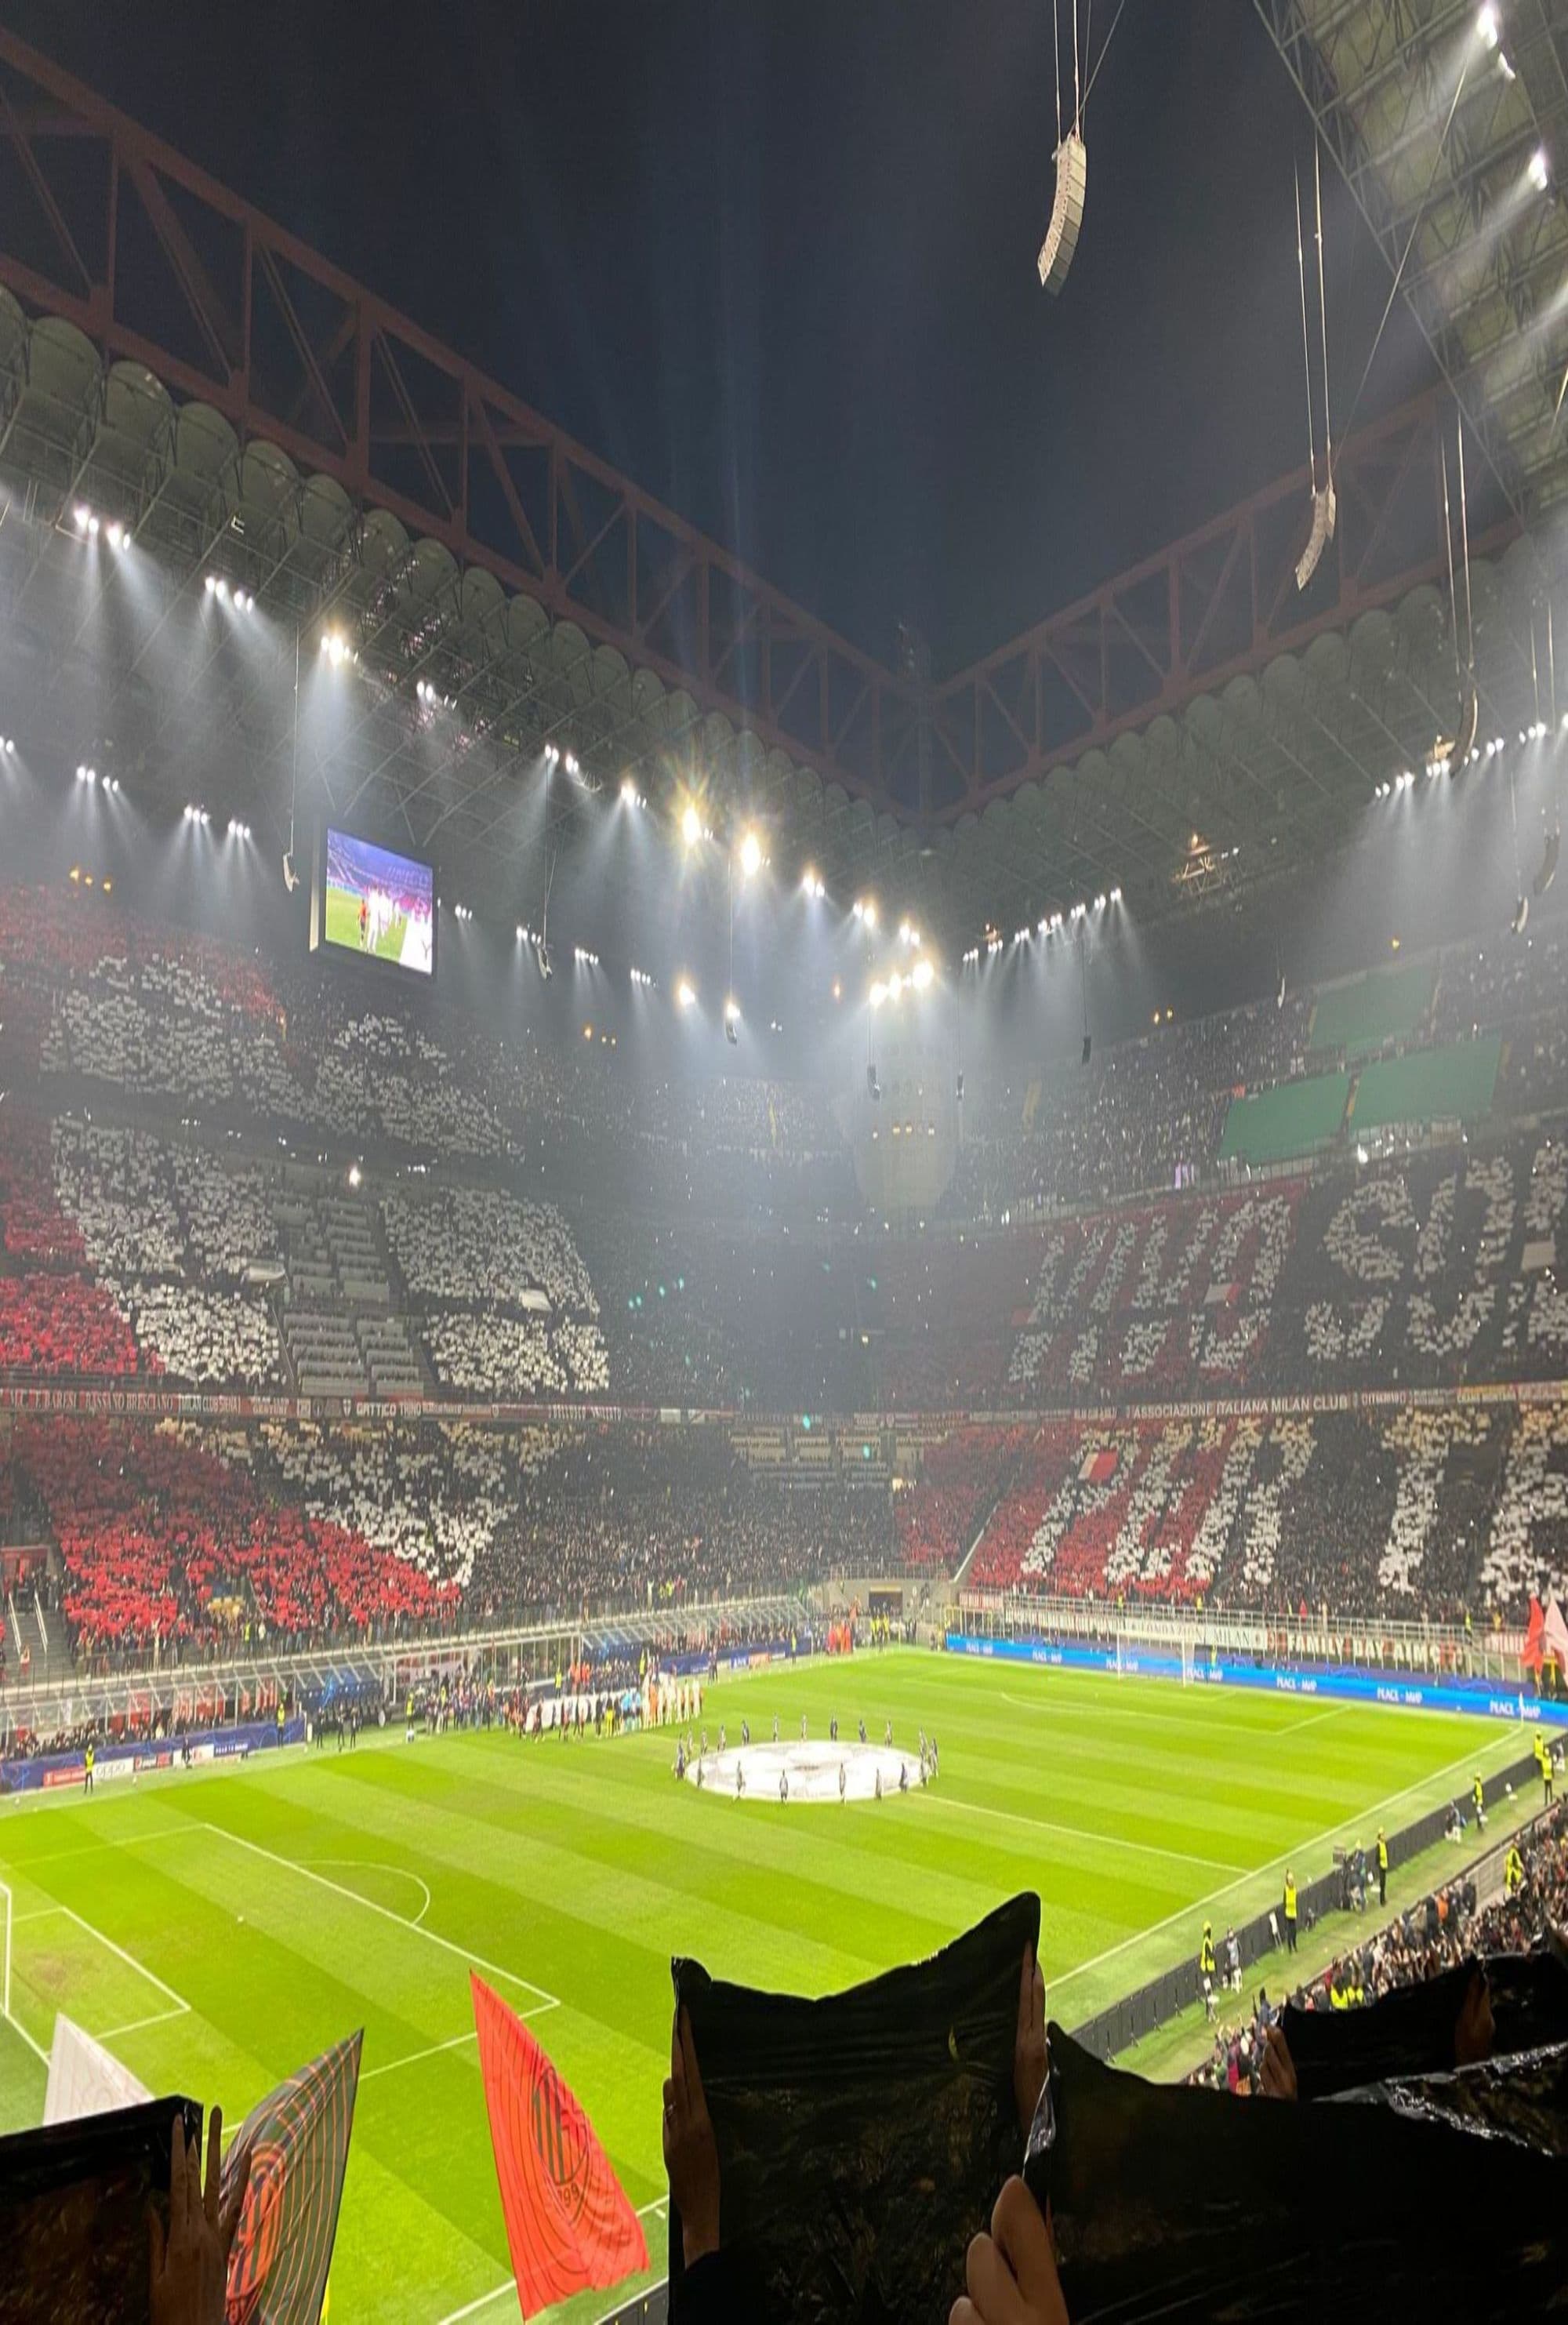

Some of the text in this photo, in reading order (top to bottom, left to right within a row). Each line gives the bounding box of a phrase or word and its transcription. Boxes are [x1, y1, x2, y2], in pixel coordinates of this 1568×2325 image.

[85, 1391, 125, 1411] BASSANO
[126, 1392, 174, 1412] BRESCIANO
[1134, 1401, 1211, 1419] ASSOCIAZIONE
[1216, 1400, 1269, 1415] ITALIANA
[1271, 1397, 1309, 1413] MILAN
[1312, 1394, 1348, 1411] CLUB
[1214, 1627, 1250, 1645] MILAN
[1288, 1631, 1344, 1656] FAMILY
[1353, 1637, 1384, 1659] DAY
